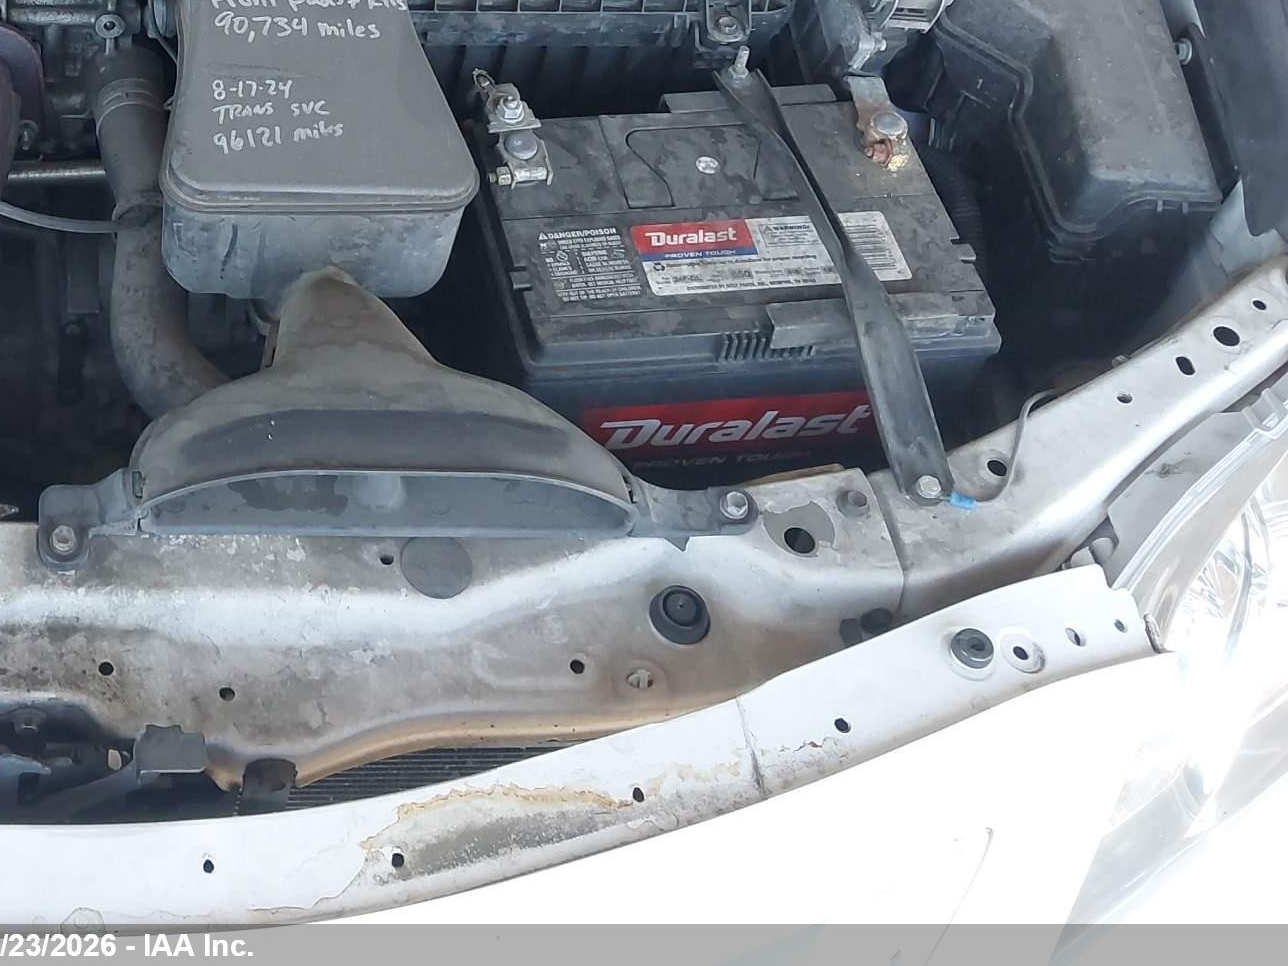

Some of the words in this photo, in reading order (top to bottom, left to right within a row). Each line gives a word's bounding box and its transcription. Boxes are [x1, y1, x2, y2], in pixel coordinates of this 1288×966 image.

[214, 11, 308, 43] 90,734
[317, 18, 381, 38] miles
[212, 79, 293, 100] 8-17-24
[213, 126, 282, 154] 96121
[644, 227, 737, 247] Duralast
[599, 405, 872, 450] Duralast
